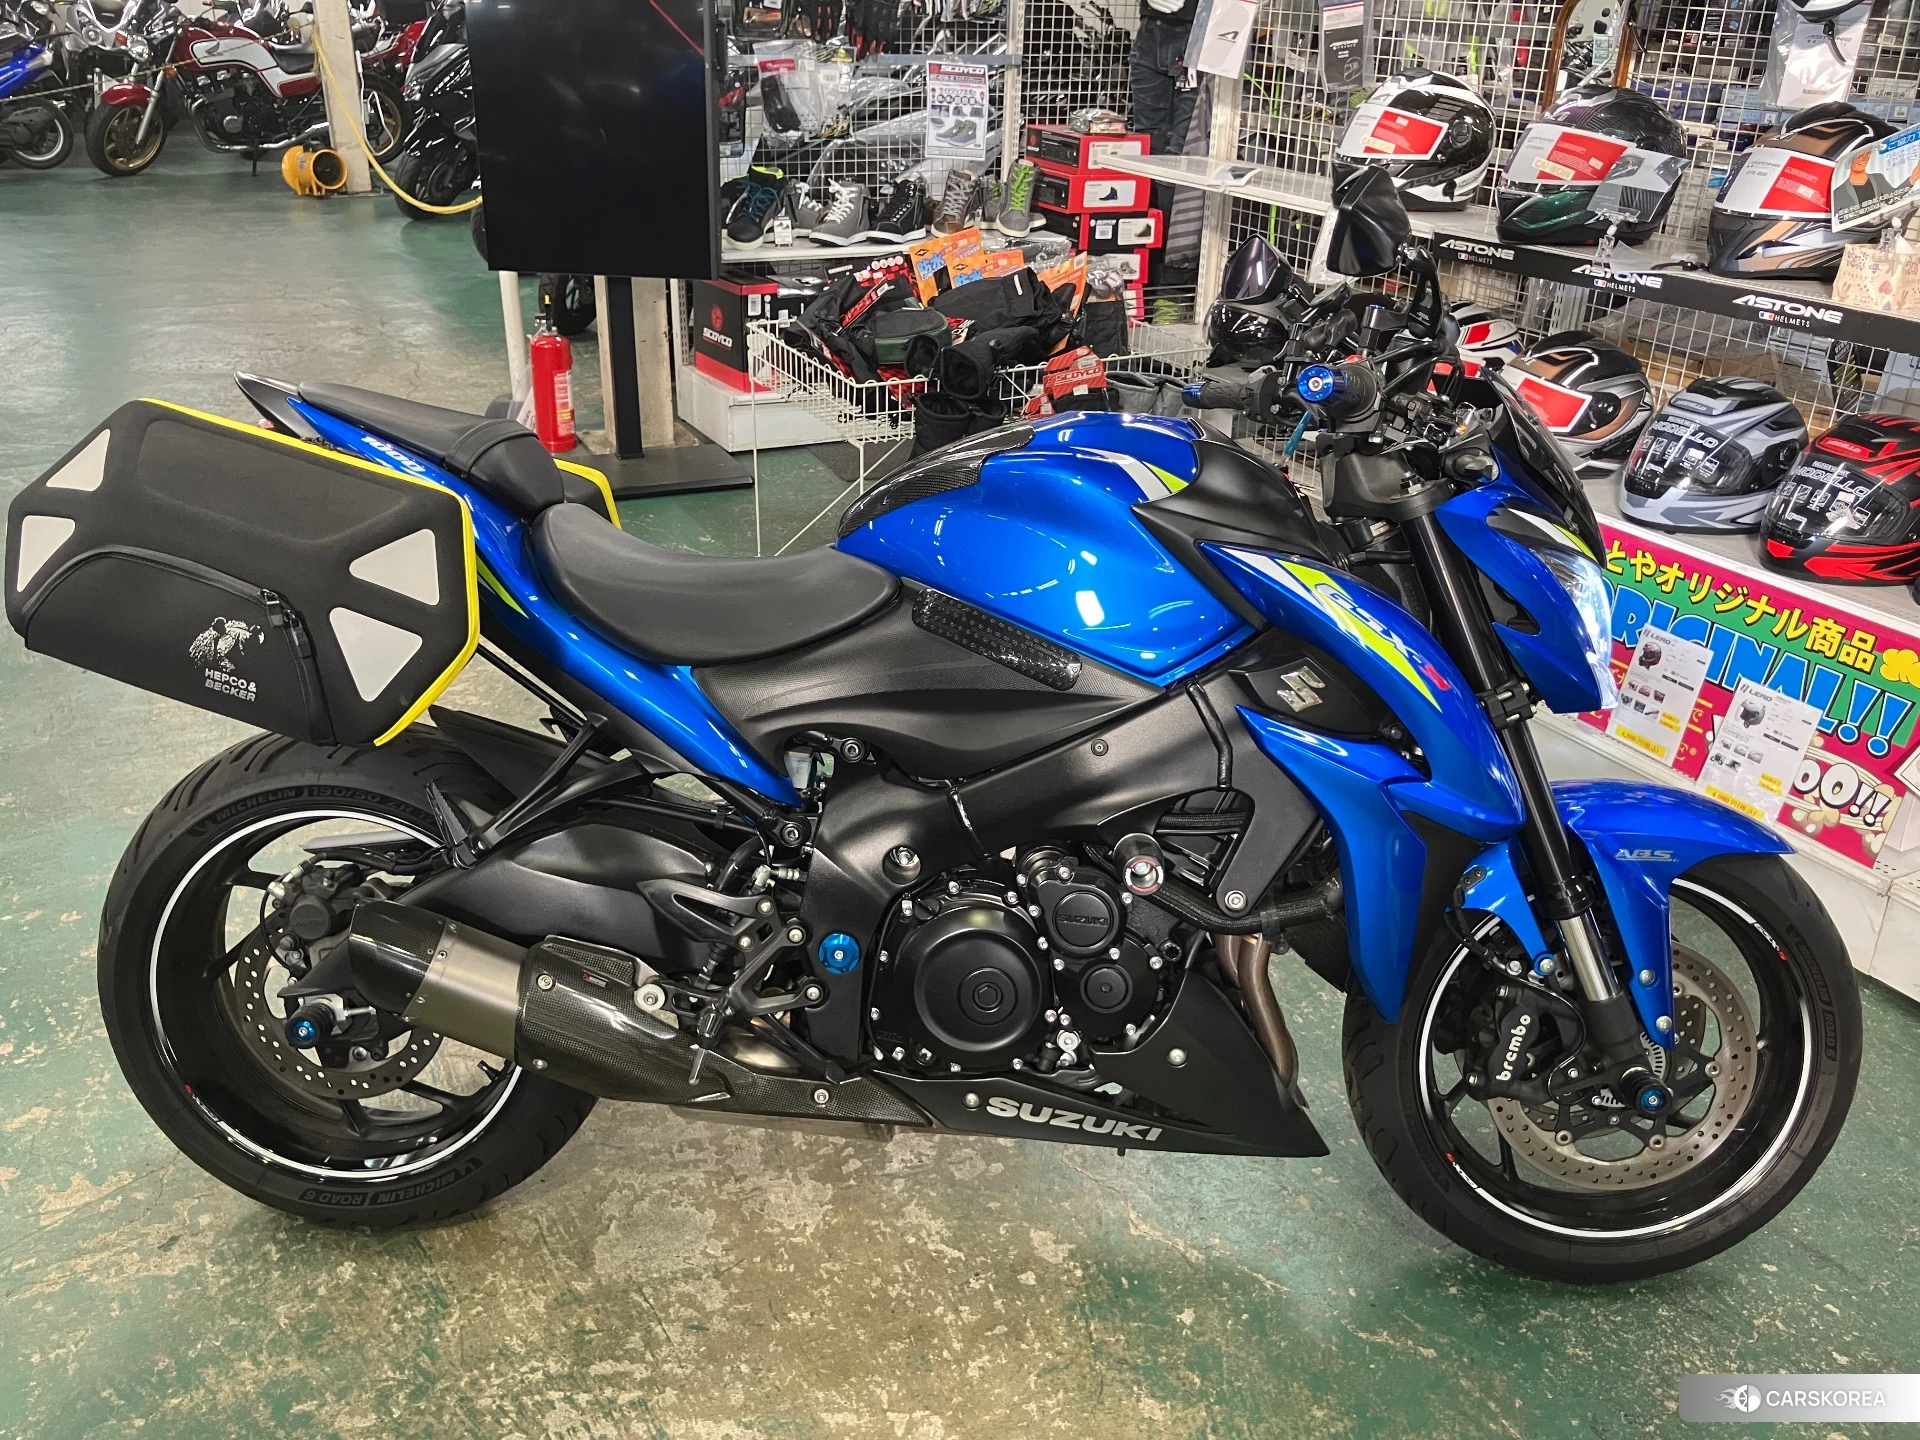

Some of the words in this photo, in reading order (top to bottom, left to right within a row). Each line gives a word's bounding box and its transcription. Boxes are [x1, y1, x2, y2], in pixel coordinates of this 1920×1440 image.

[940, 64, 985, 74] SCOYCO
[1439, 239, 1515, 260] ASTONE
[1468, 255, 1493, 265] HELMETS
[917, 253, 946, 275] 防水
[1572, 264, 1663, 288] ASTONE
[1606, 281, 1636, 292] HELMETS
[1732, 294, 1844, 324] ASTONE
[1774, 315, 1811, 328] HELMETS
[703, 327, 733, 348] SCOYCO
[1055, 366, 1102, 382] SCOYCO
[361, 436, 426, 472] 1000
[1606, 539, 1877, 675] とやオリジナル商品
[1650, 634, 1671, 646] LEAD
[205, 679, 256, 702] BECKER
[1748, 689, 1773, 702] LEAD
[216, 787, 297, 822] MICHELIN
[311, 785, 381, 802] 190/50
[385, 798, 414, 814] ZR
[1615, 849, 1674, 860] ABS
[1058, 914, 1108, 926] SUZUKI
[1799, 940, 1831, 1003] MICHELIN
[1824, 1012, 1836, 1046] ROAD
[1496, 1014, 1531, 1081] brembo
[986, 1096, 1163, 1142] SUZUKI
[318, 1192, 364, 1205] ROAD
[377, 1173, 455, 1204] MICHELIN
